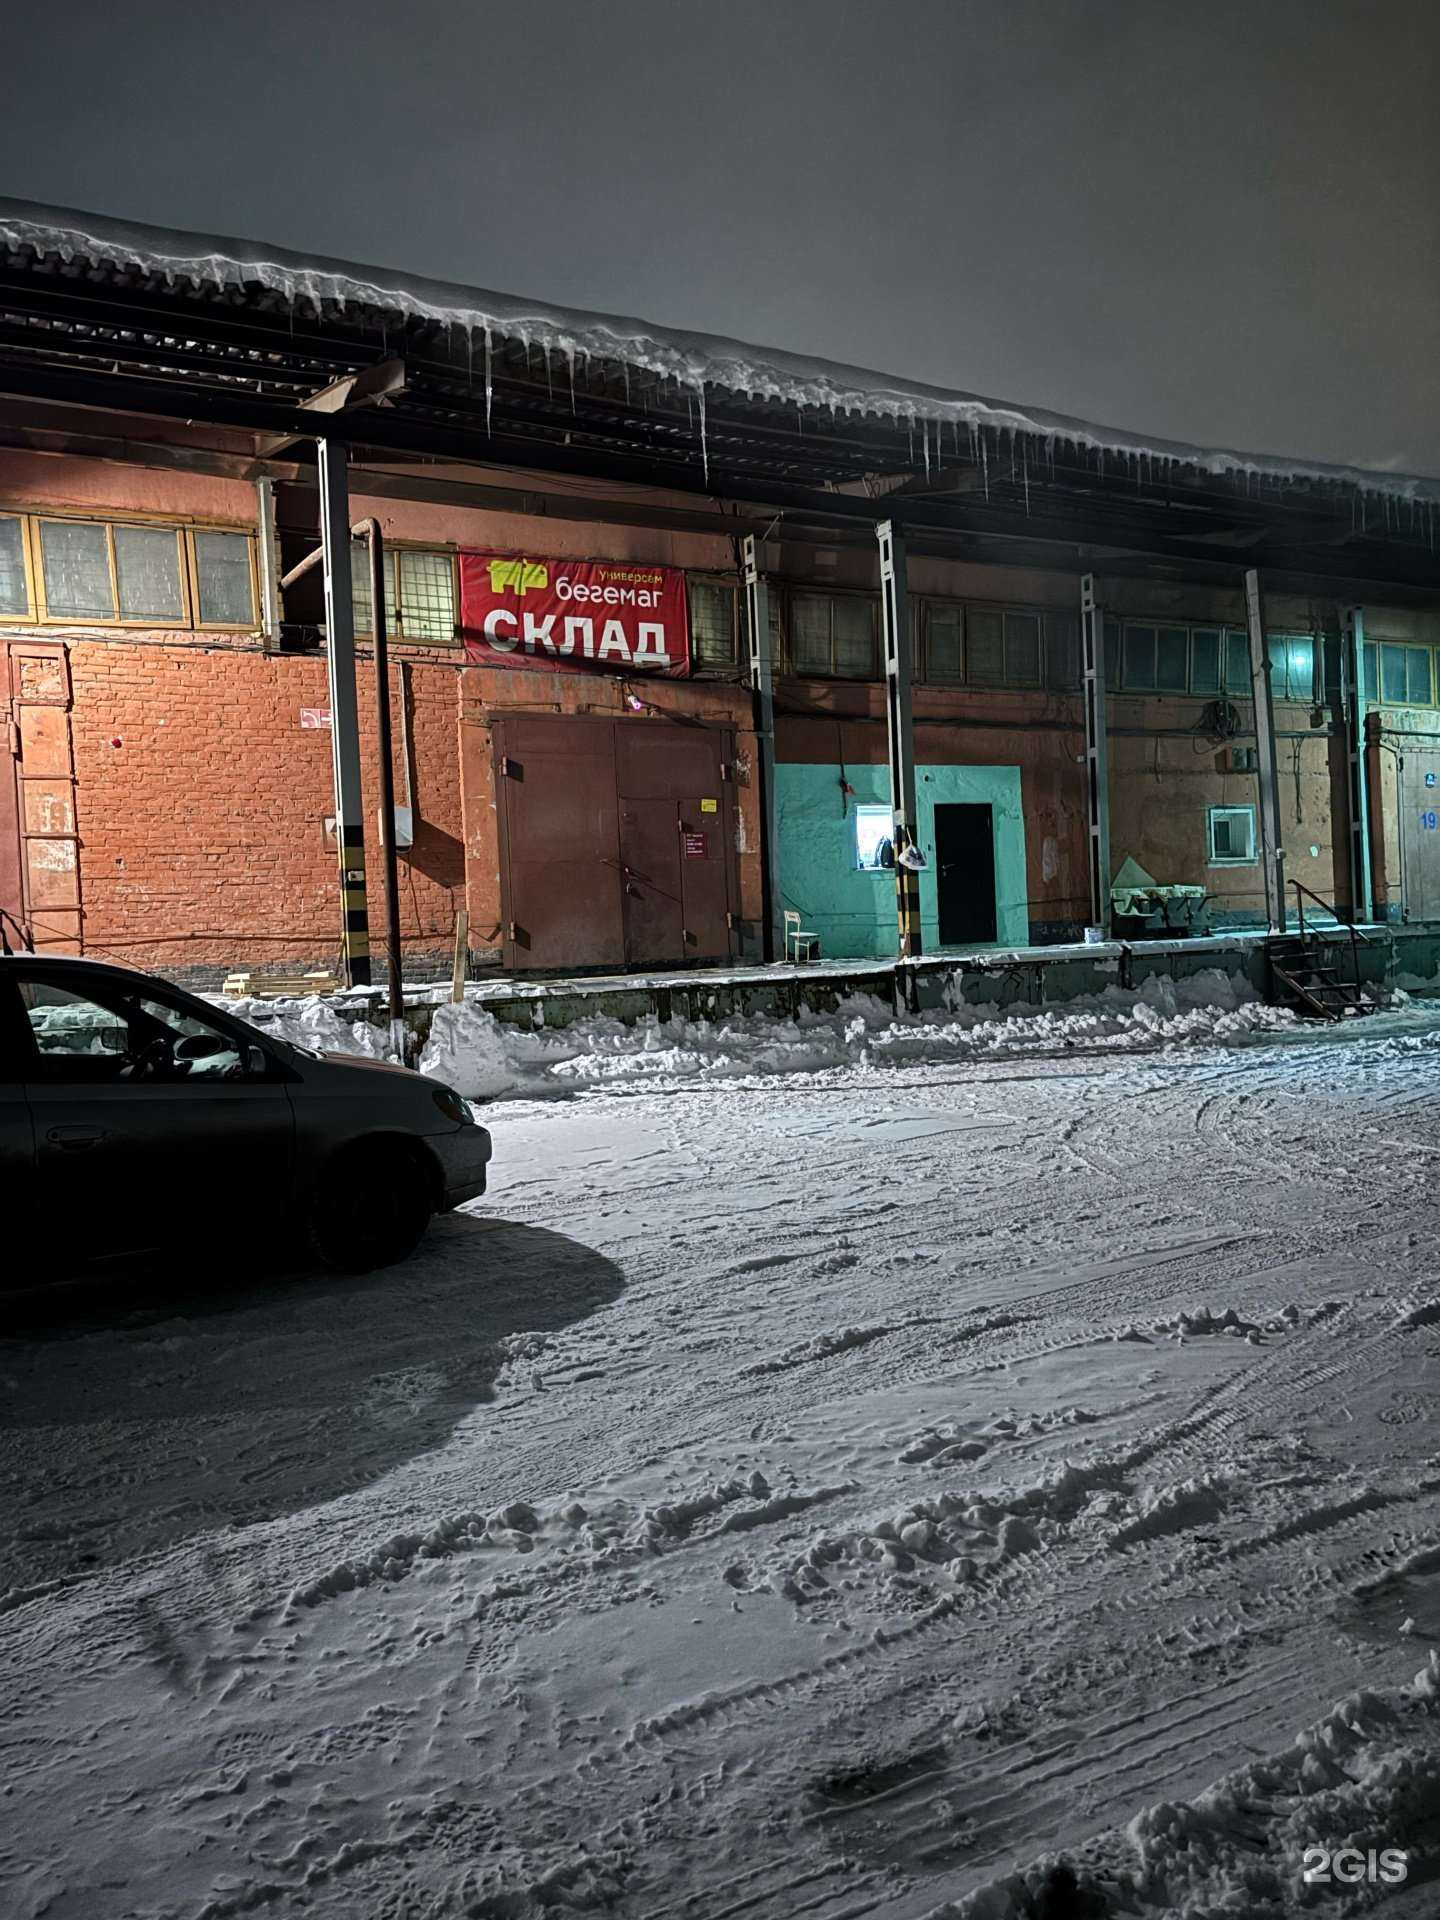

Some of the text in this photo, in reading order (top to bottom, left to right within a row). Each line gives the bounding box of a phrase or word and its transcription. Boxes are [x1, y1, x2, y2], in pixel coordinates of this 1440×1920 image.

[599, 570, 663, 586] универсам
[483, 609, 671, 671] СКЛАД
[1421, 811, 1437, 830] 19
